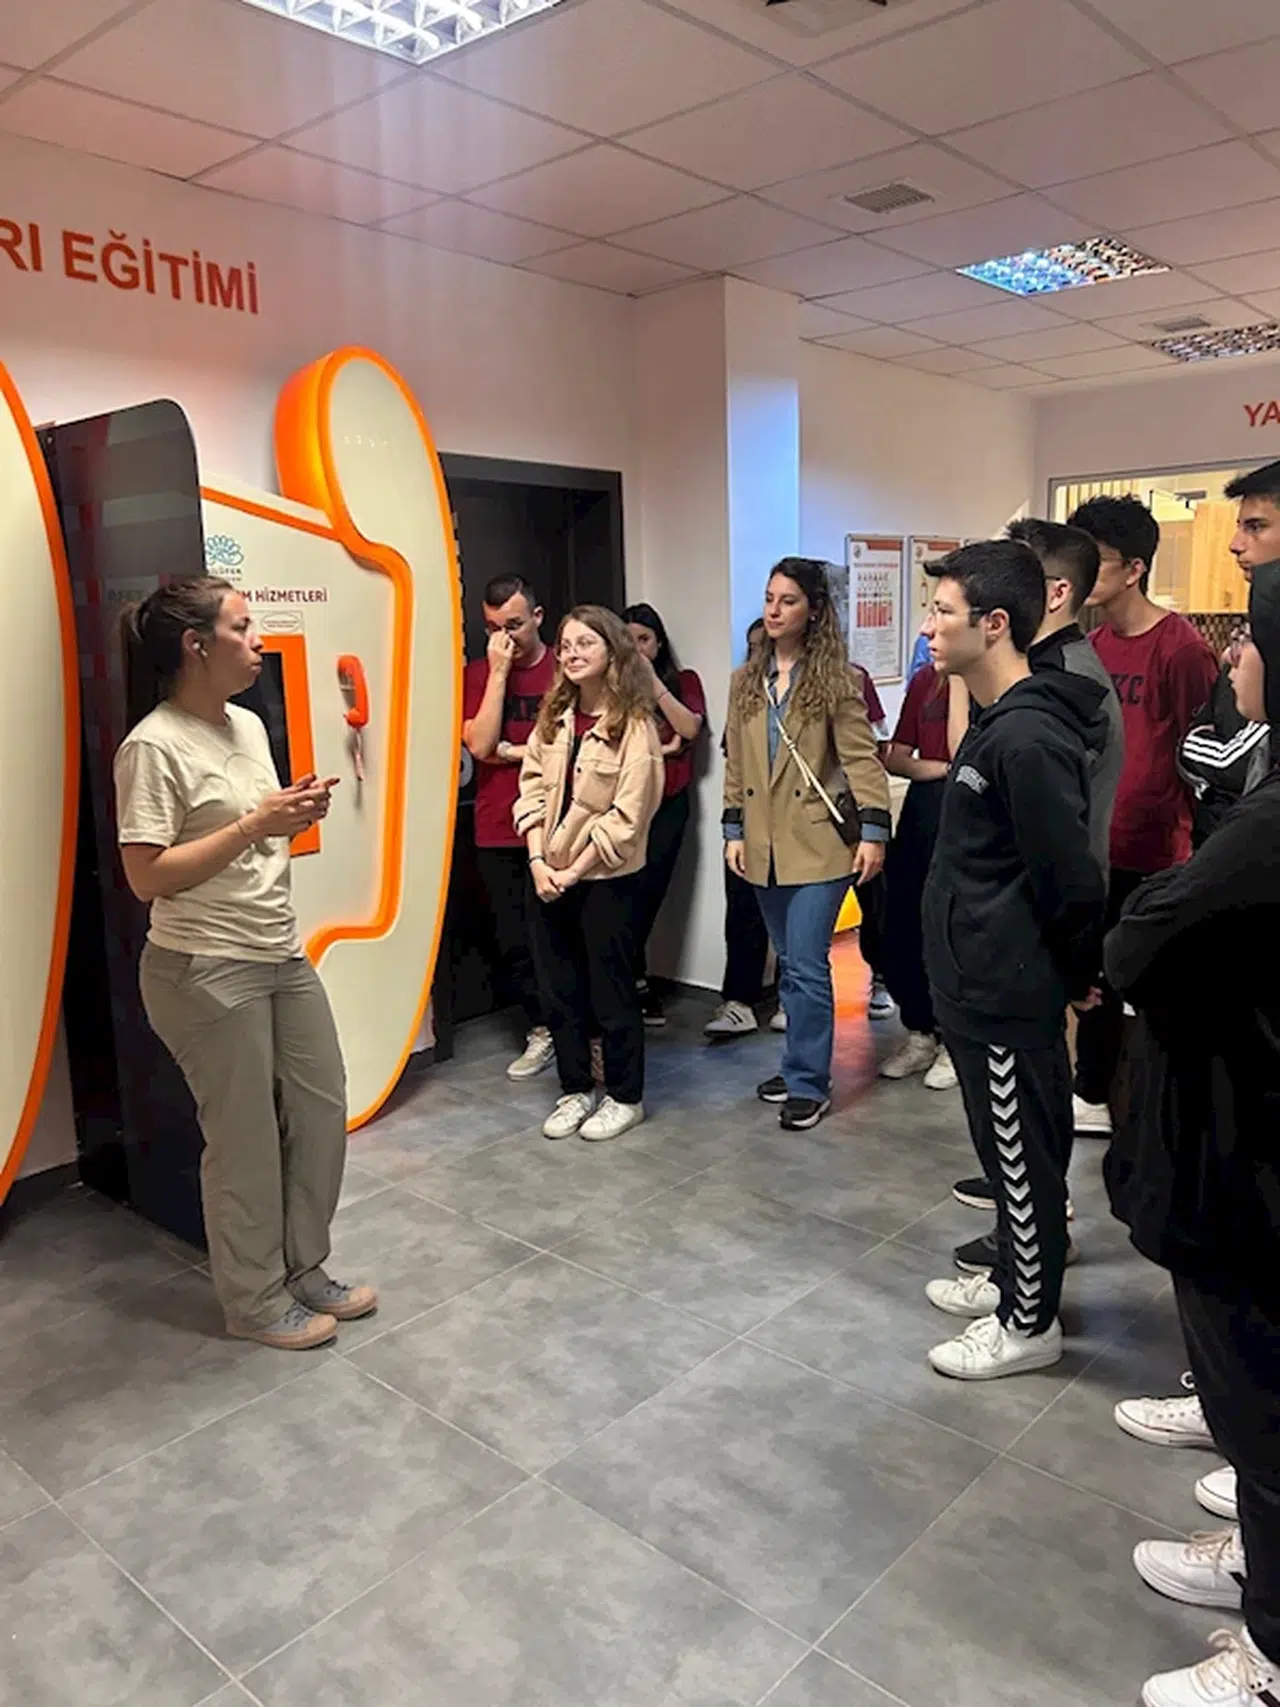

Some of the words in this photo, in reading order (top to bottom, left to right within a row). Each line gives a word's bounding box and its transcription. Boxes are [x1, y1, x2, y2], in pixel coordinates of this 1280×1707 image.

[62, 228, 259, 315] EĞİTİMİ
[1243, 400, 1280, 428] YA
[255, 586, 328, 603] HİZMETLERİ
